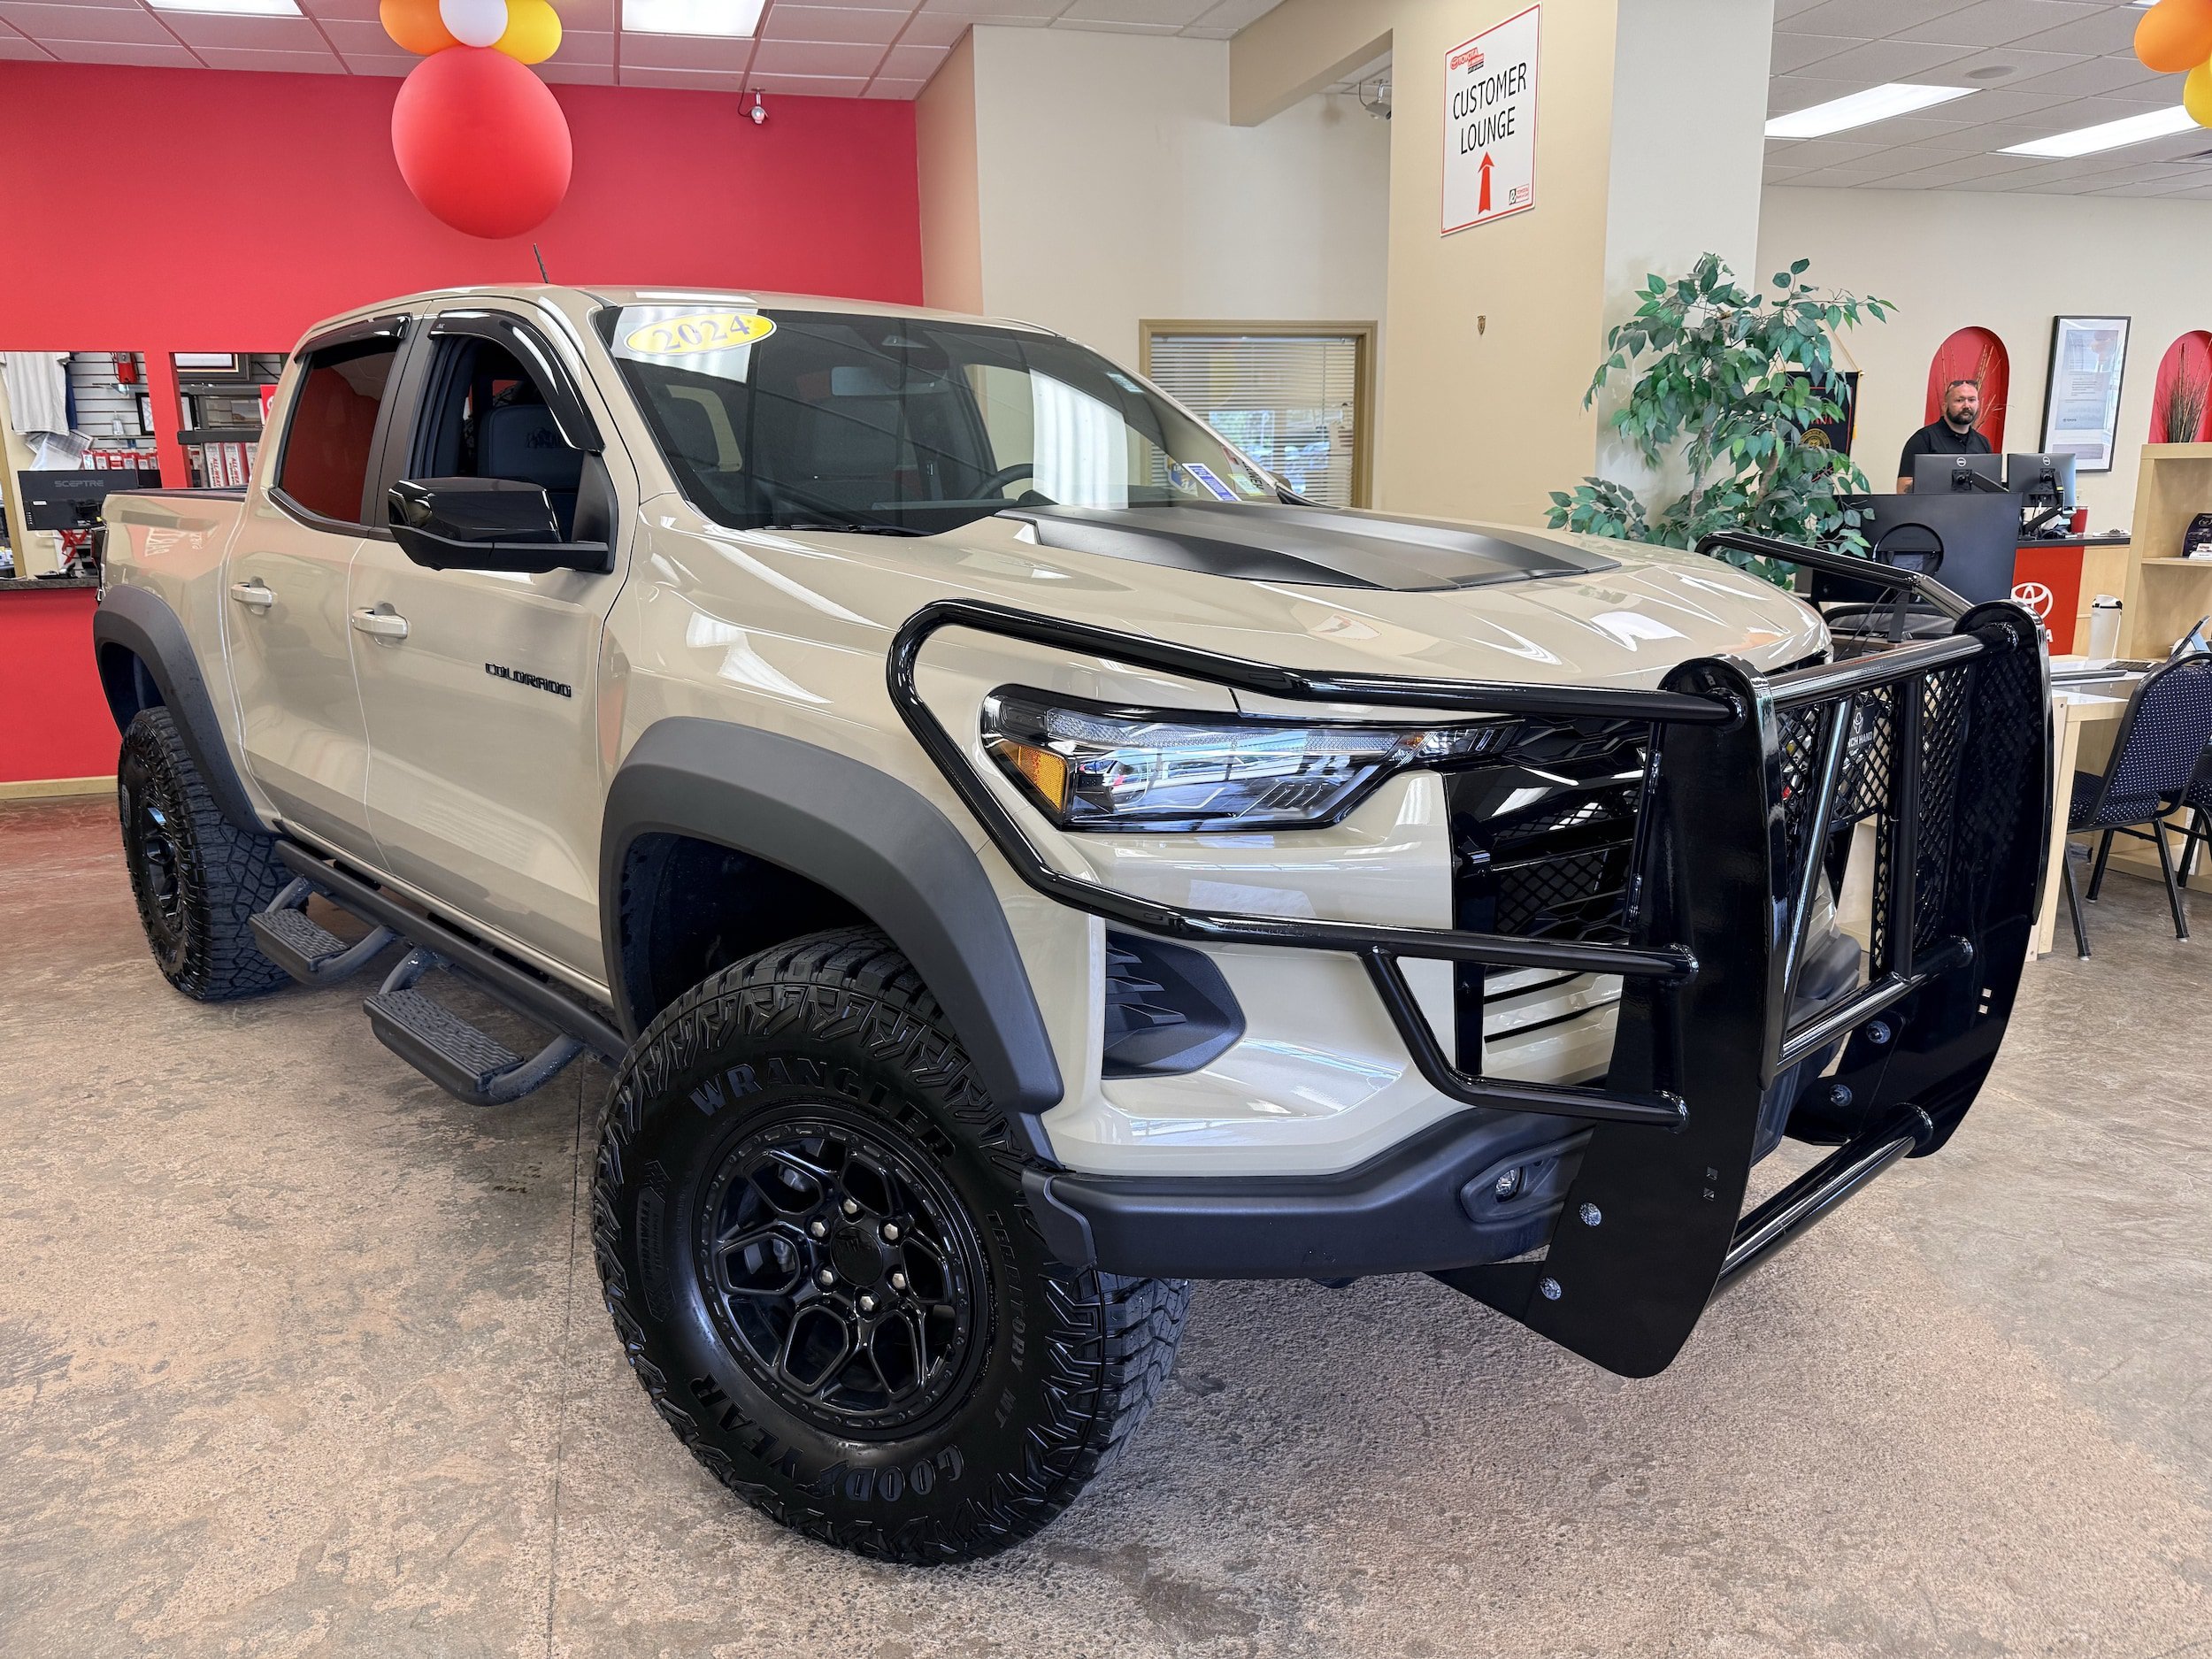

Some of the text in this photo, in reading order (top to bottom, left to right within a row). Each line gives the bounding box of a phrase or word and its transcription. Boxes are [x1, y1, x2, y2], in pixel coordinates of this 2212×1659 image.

[1453, 62, 1526, 120] CUSTOMER
[1461, 105, 1516, 155] LOUNGE
[652, 314, 749, 351] 2024
[485, 663, 572, 698] COLORADO
[1859, 731, 1873, 744] HAND
[687, 1057, 956, 1166] WRANGLER
[986, 1210, 1026, 1372] TERRITORY
[688, 1372, 964, 1502] GOODYEAR
